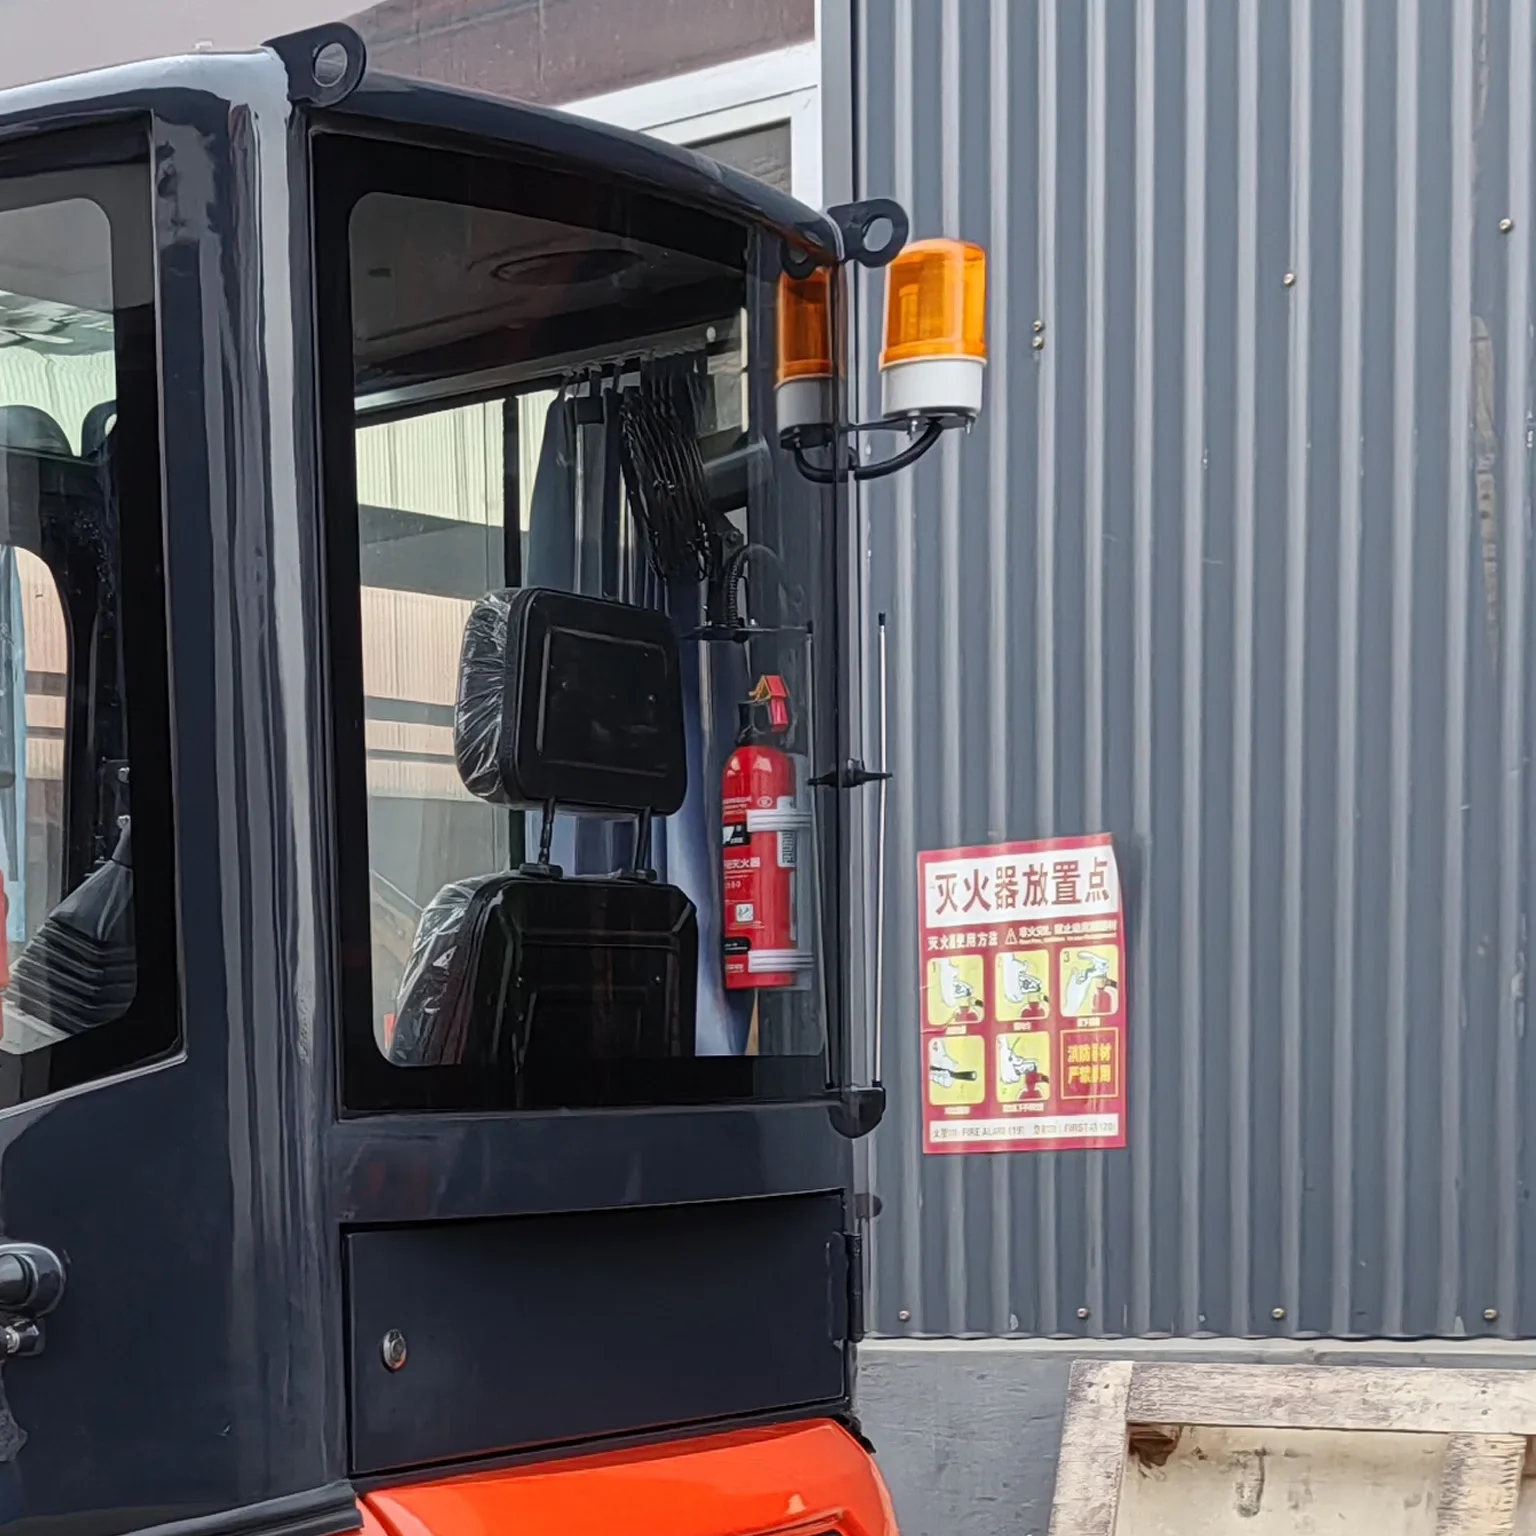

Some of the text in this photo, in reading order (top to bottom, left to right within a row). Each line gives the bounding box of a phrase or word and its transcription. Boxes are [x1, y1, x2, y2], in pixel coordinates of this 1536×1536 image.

[935, 856, 1111, 916] 灭火器放置点
